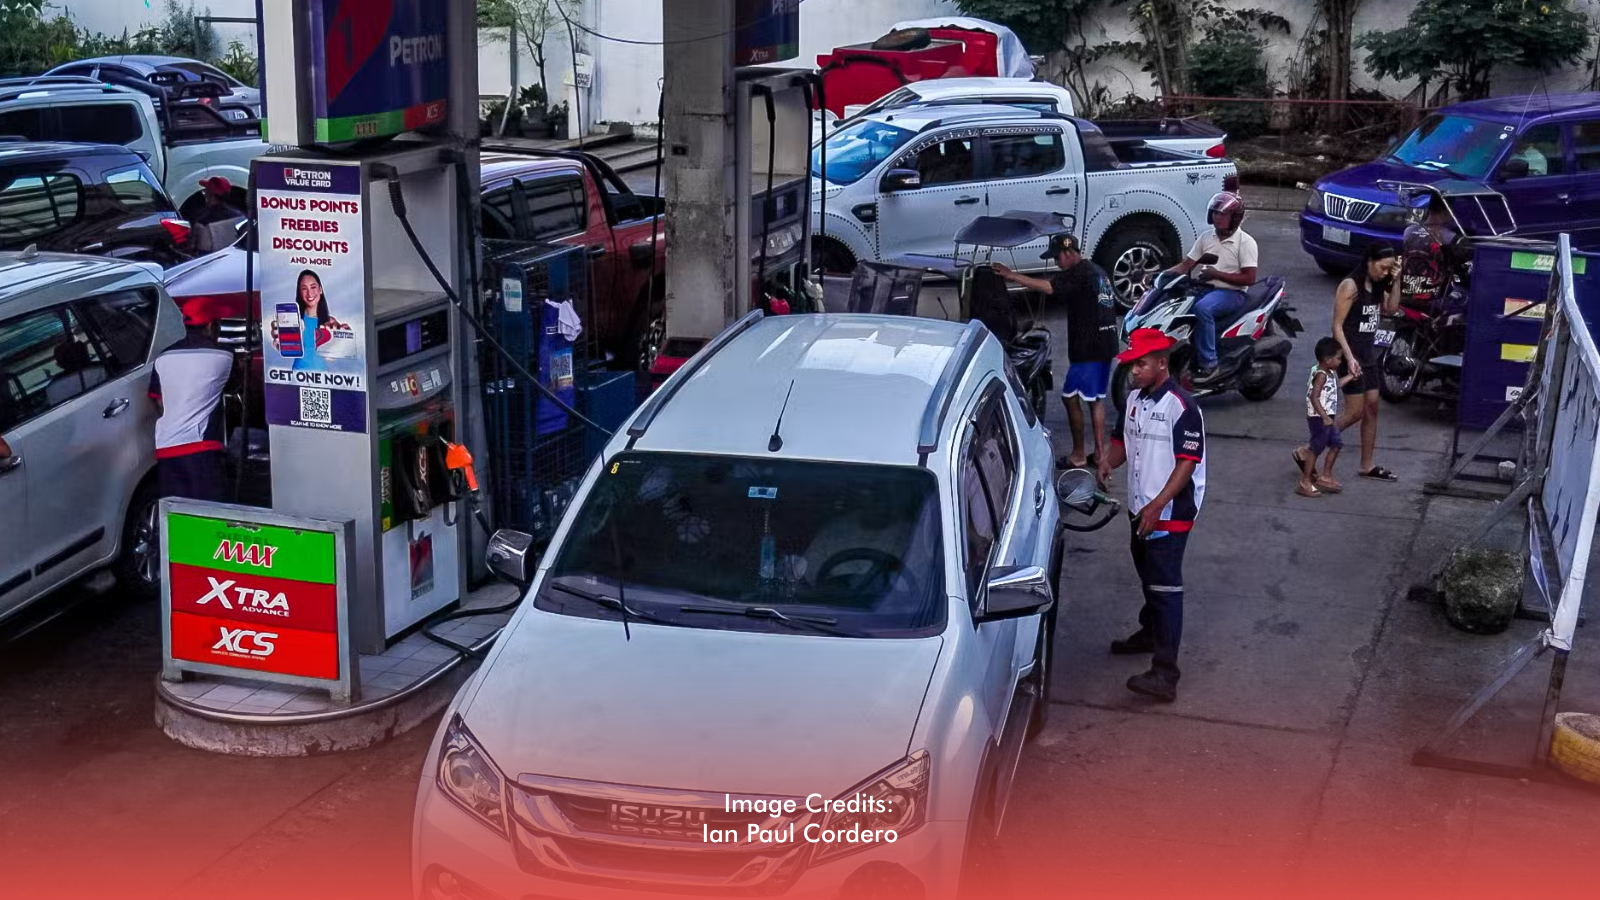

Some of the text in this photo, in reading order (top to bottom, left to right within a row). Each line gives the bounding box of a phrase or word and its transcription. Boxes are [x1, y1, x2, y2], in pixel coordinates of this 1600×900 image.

[389, 34, 442, 67] PETRON
[426, 104, 438, 119] XCS
[294, 168, 331, 180] PETRON
[285, 178, 331, 188] VALUE CARD
[260, 196, 358, 214] BONUS POINTS
[281, 218, 338, 233] FREEBIES
[272, 237, 348, 254] DISCOUNTS
[309, 258, 332, 266] MORE
[269, 369, 293, 382] GET
[296, 372, 322, 385] ONE
[418, 446, 427, 484] XCS
[216, 530, 273, 546] DIESEL
[213, 539, 278, 568] MAX
[196, 576, 290, 610] XTRA
[241, 606, 290, 617] ADVANCE
[212, 626, 278, 656] XCS
[611, 803, 705, 827] ISUZU
